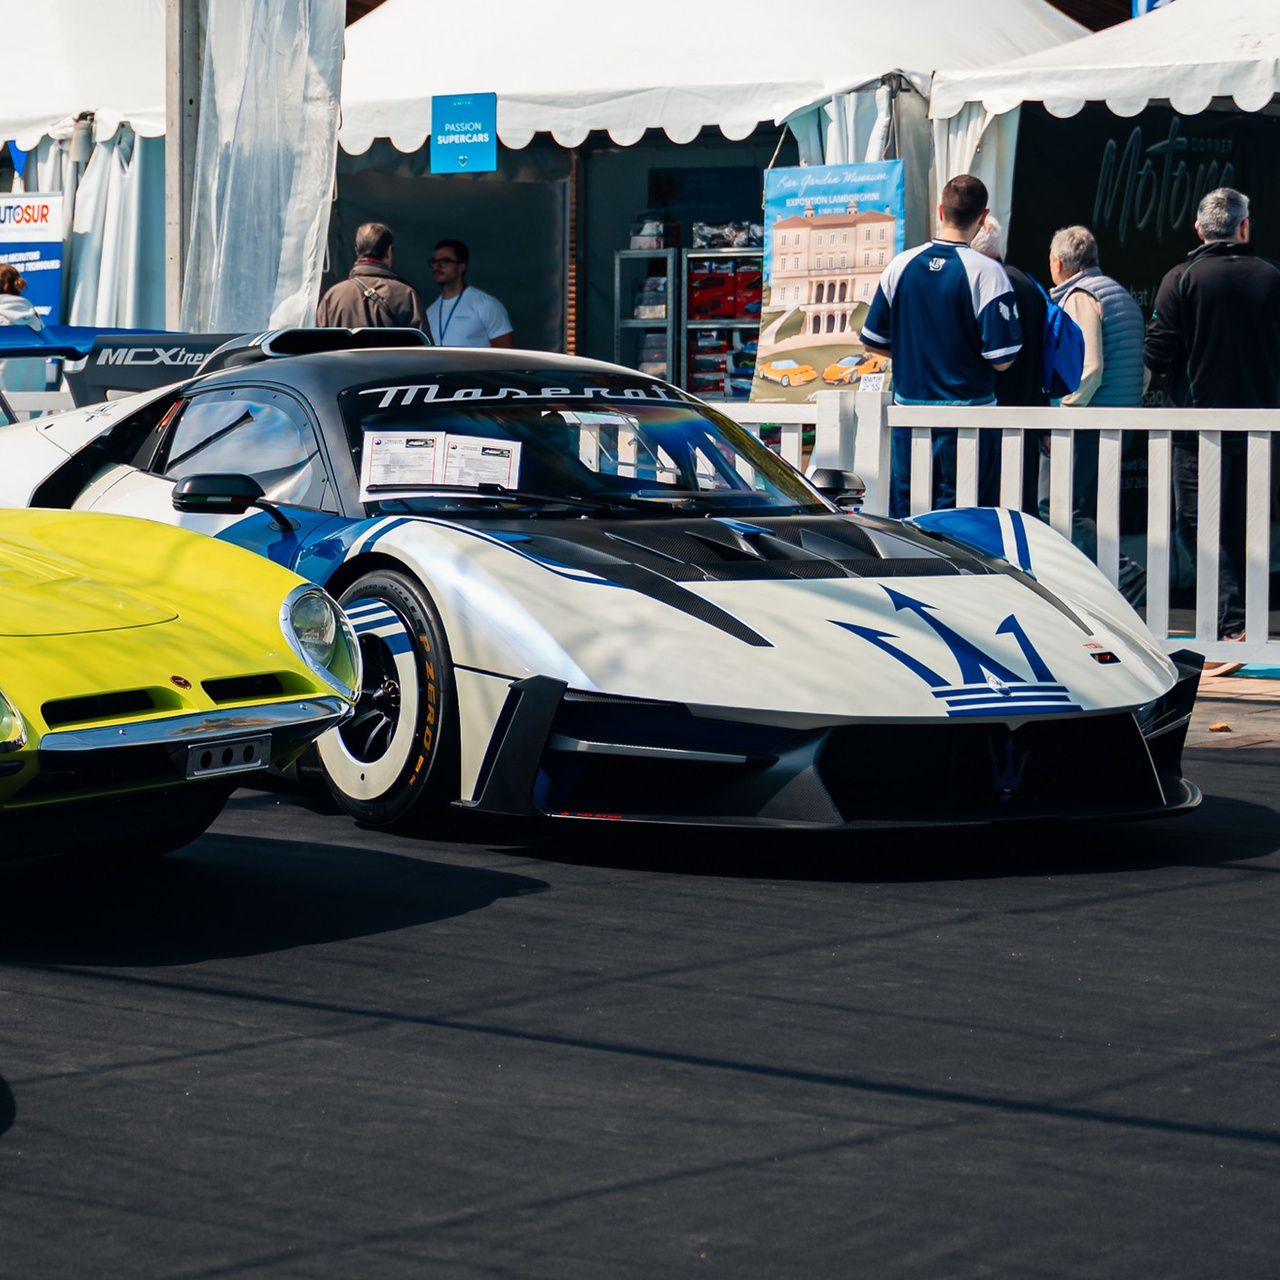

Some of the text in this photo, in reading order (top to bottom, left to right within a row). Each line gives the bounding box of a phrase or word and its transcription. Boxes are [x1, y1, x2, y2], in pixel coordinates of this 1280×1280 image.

[444, 122, 482, 132] PASSION
[437, 133, 490, 145] SUPERCARS
[1191, 136, 1233, 153] CORNER
[786, 192, 880, 207] EXPOSITION LAMBORGHINI
[96, 347, 210, 366] MCXtre
